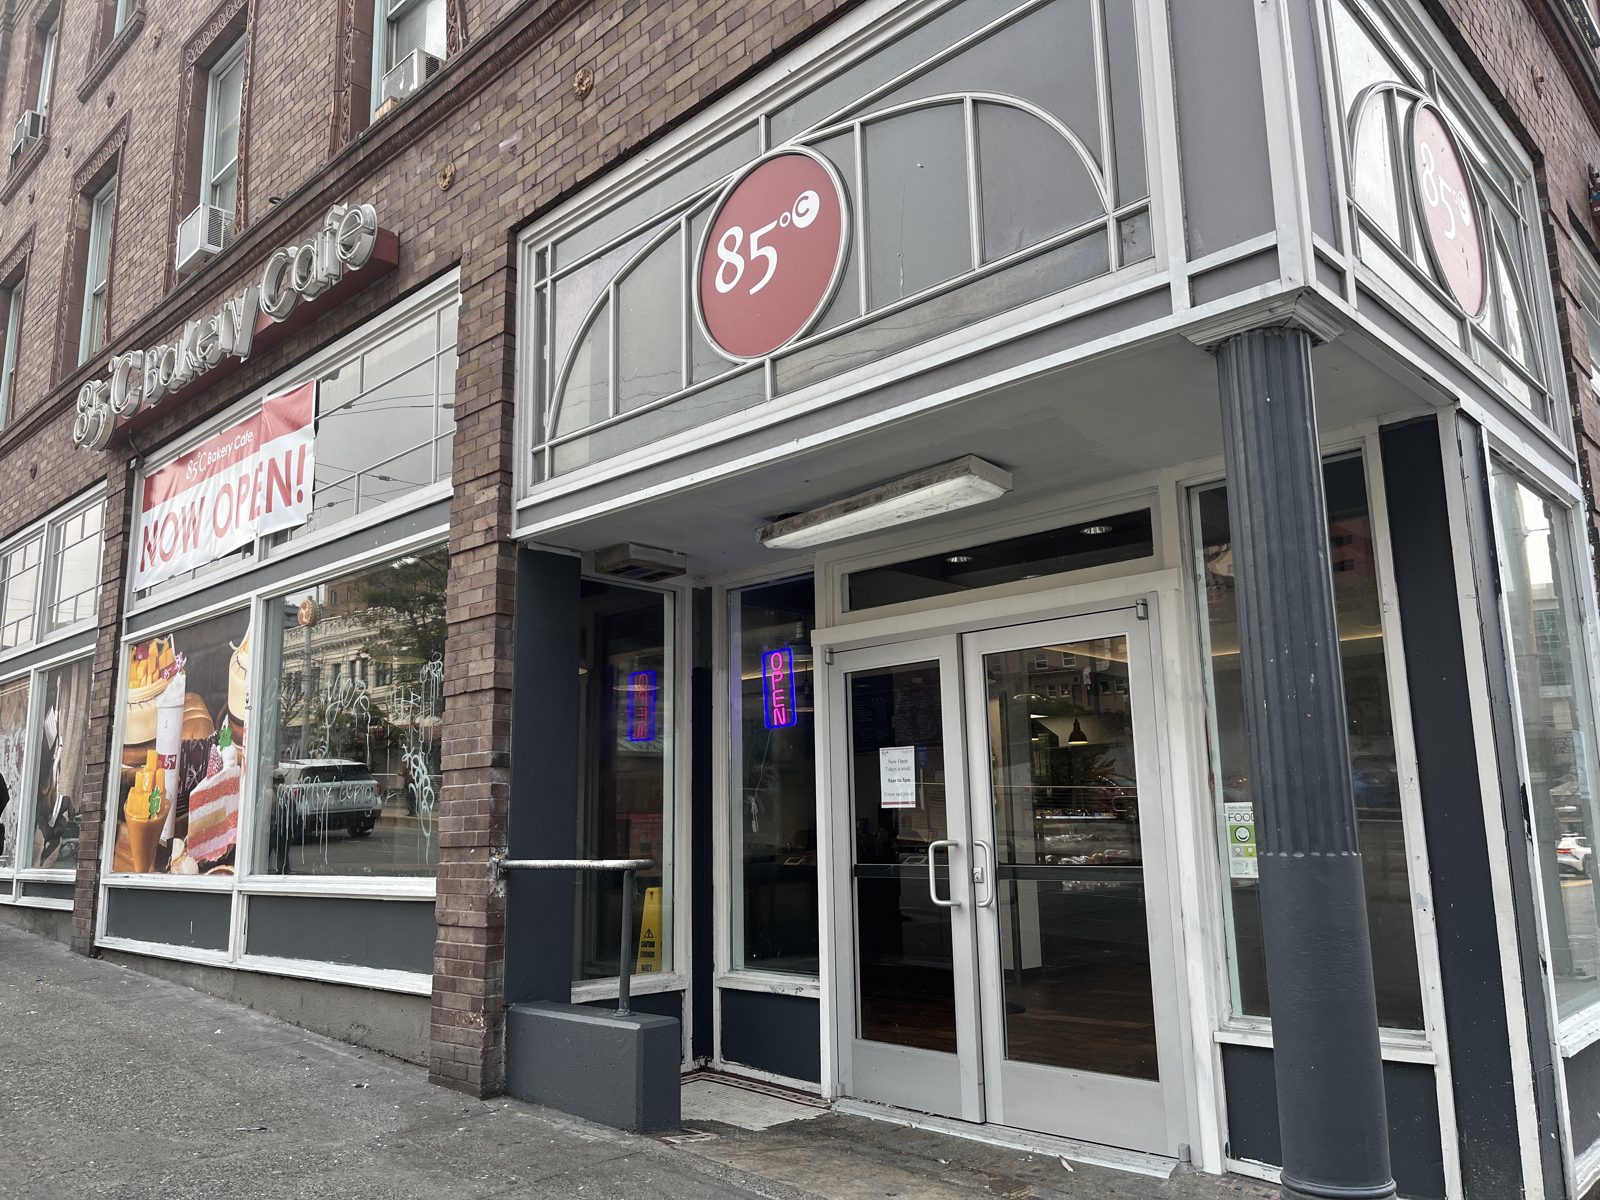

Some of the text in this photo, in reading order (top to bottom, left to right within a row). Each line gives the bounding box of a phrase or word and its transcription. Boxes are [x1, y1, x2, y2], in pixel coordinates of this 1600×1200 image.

[715, 189, 820, 296] 85°C
[143, 285, 260, 409] Bakery
[260, 202, 378, 323] Cafe
[140, 443, 307, 573] NOW OPEN!
[186, 430, 254, 482] 85°C Bakery Cafe
[771, 652, 787, 726] OPEN
